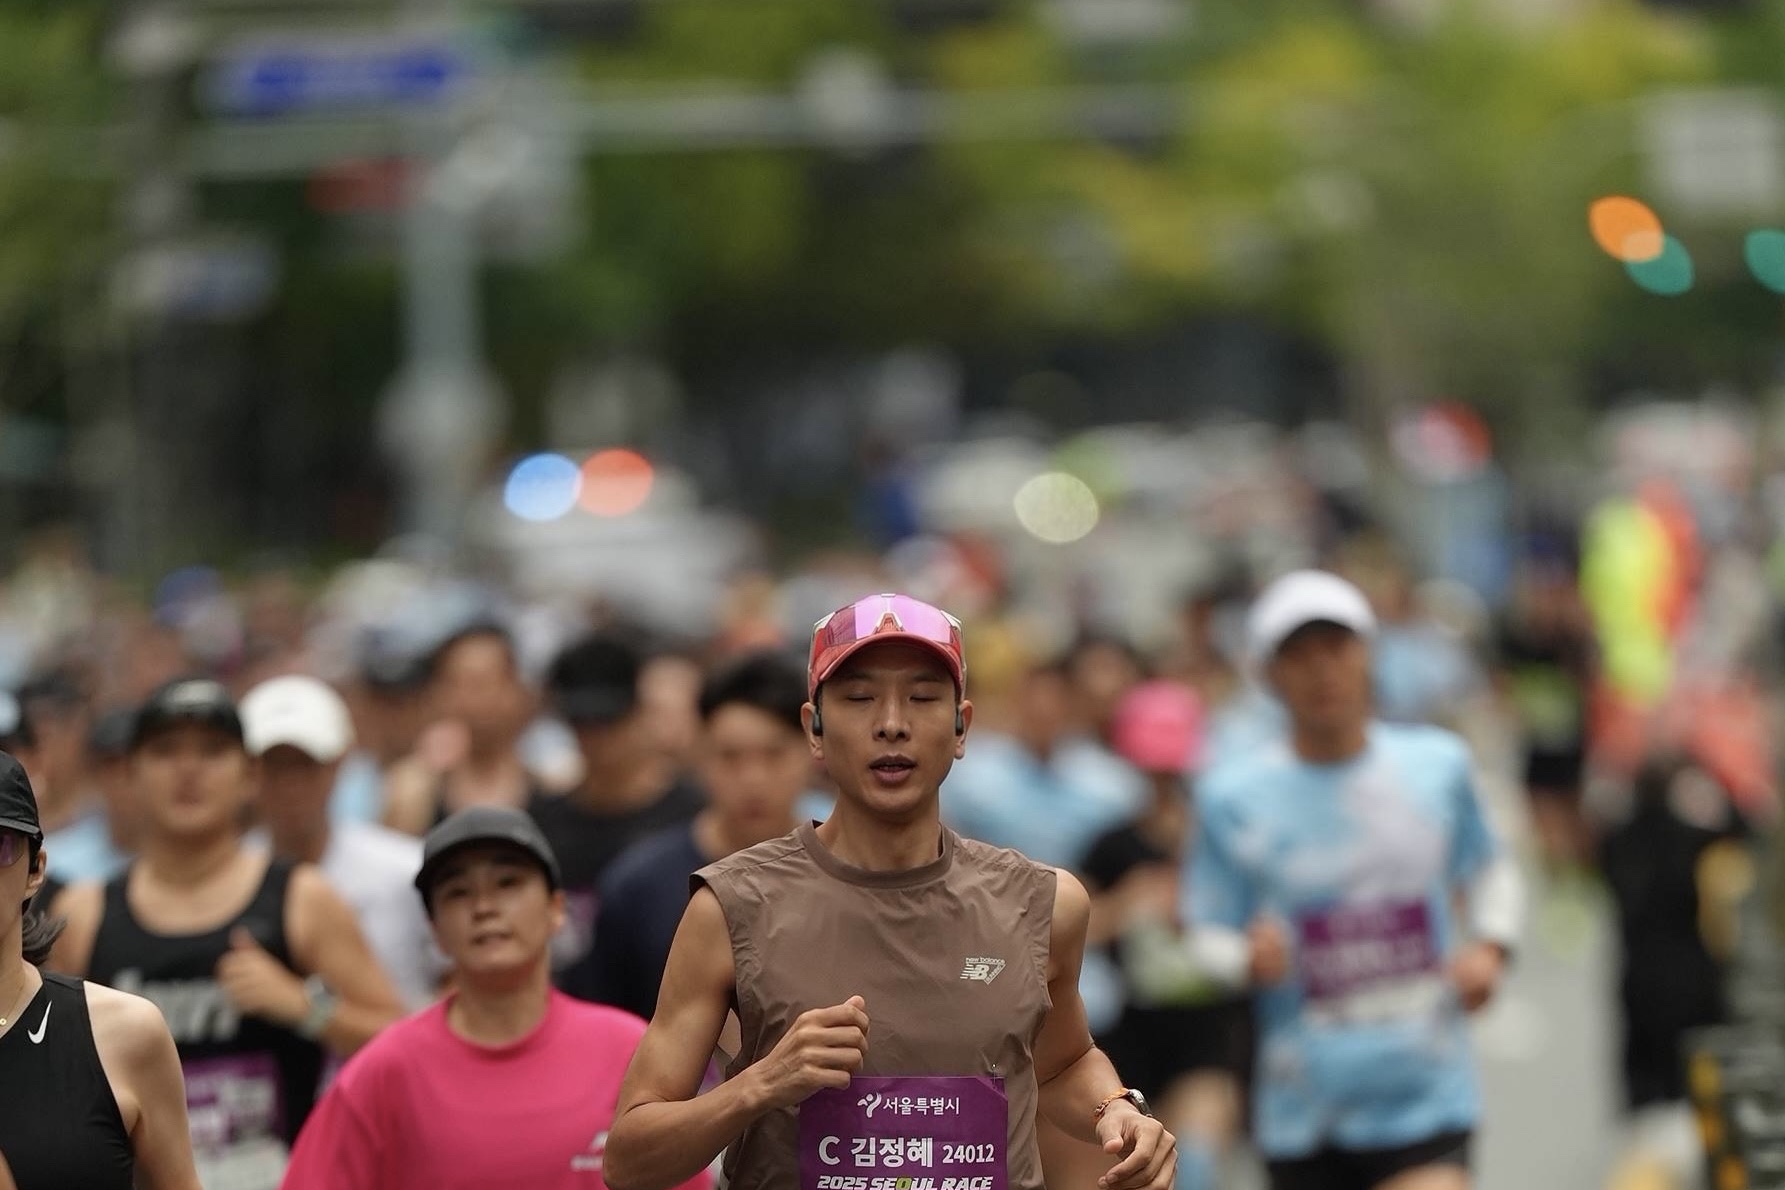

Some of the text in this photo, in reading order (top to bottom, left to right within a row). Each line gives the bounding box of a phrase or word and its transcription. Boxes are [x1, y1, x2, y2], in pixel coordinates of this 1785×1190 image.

[883, 1096, 960, 1116] 서울특별시
[818, 1135, 995, 1168] C 김정혜 24012
[817, 1175, 868, 1190] 2025
